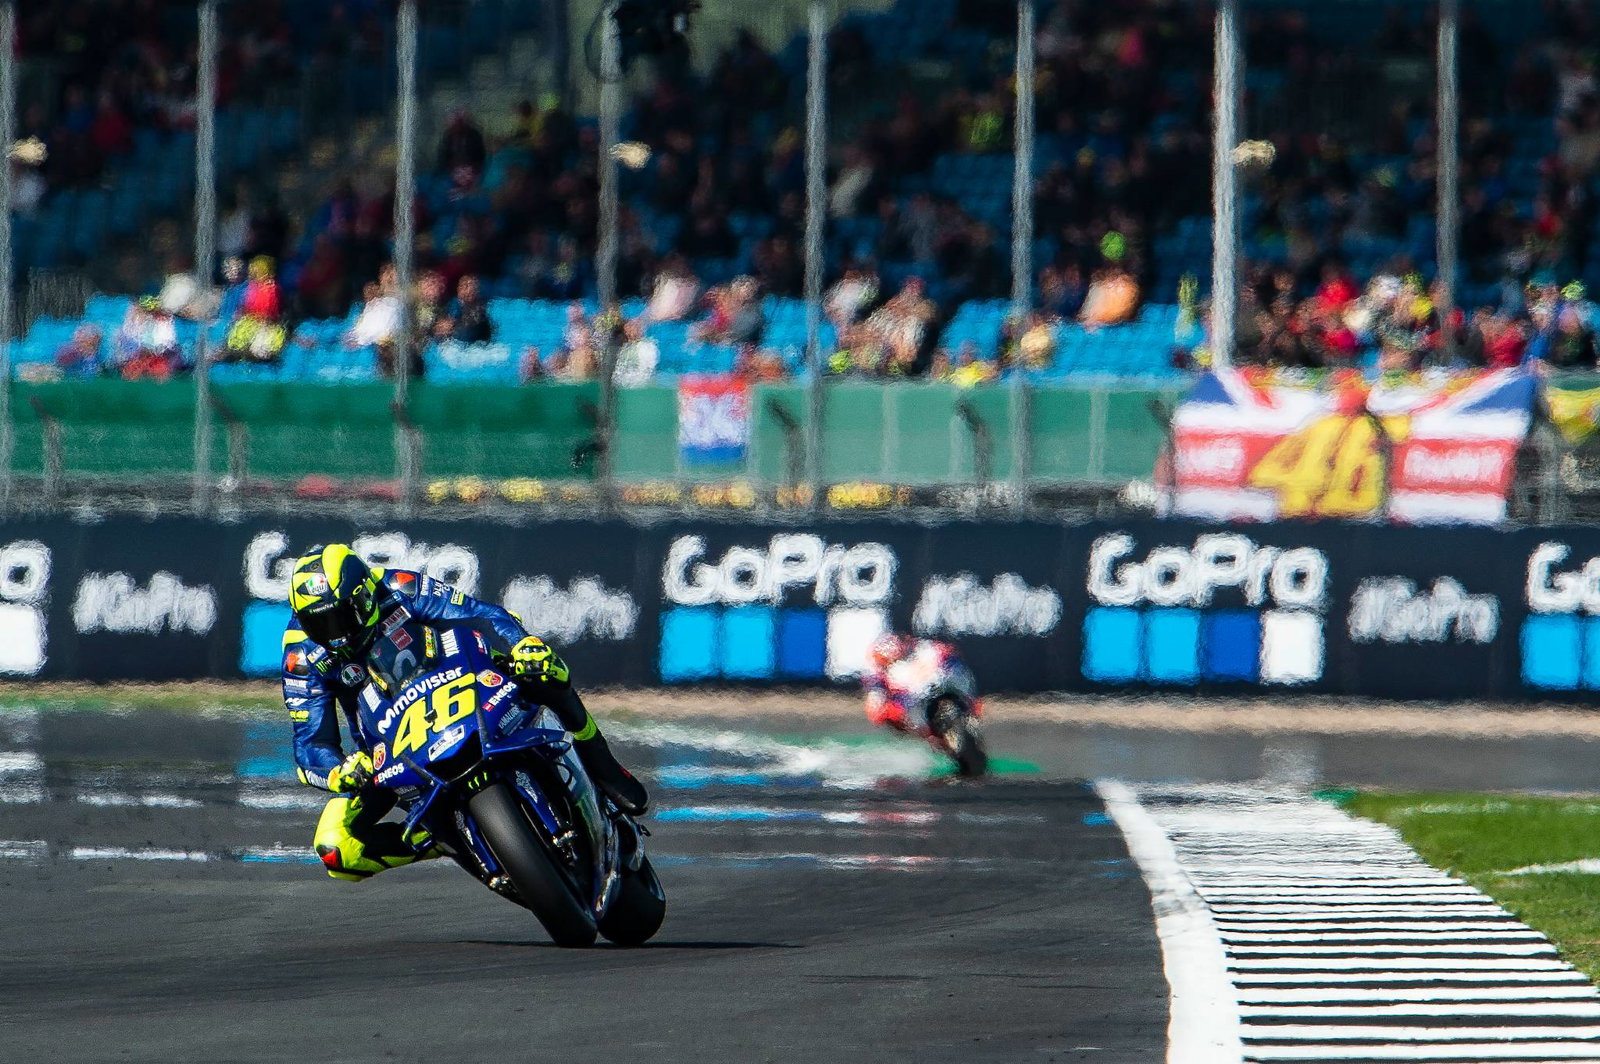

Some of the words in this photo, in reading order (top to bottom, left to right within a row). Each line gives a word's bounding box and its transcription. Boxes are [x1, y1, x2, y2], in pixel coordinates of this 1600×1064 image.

[1249, 413, 1388, 514] 46
[661, 533, 898, 605] GoPro
[1087, 532, 1329, 608] GoPro
[392, 666, 463, 716] movistar
[392, 672, 476, 759] 46
[488, 681, 517, 706] ENEOS
[377, 762, 405, 783] ENEOS
